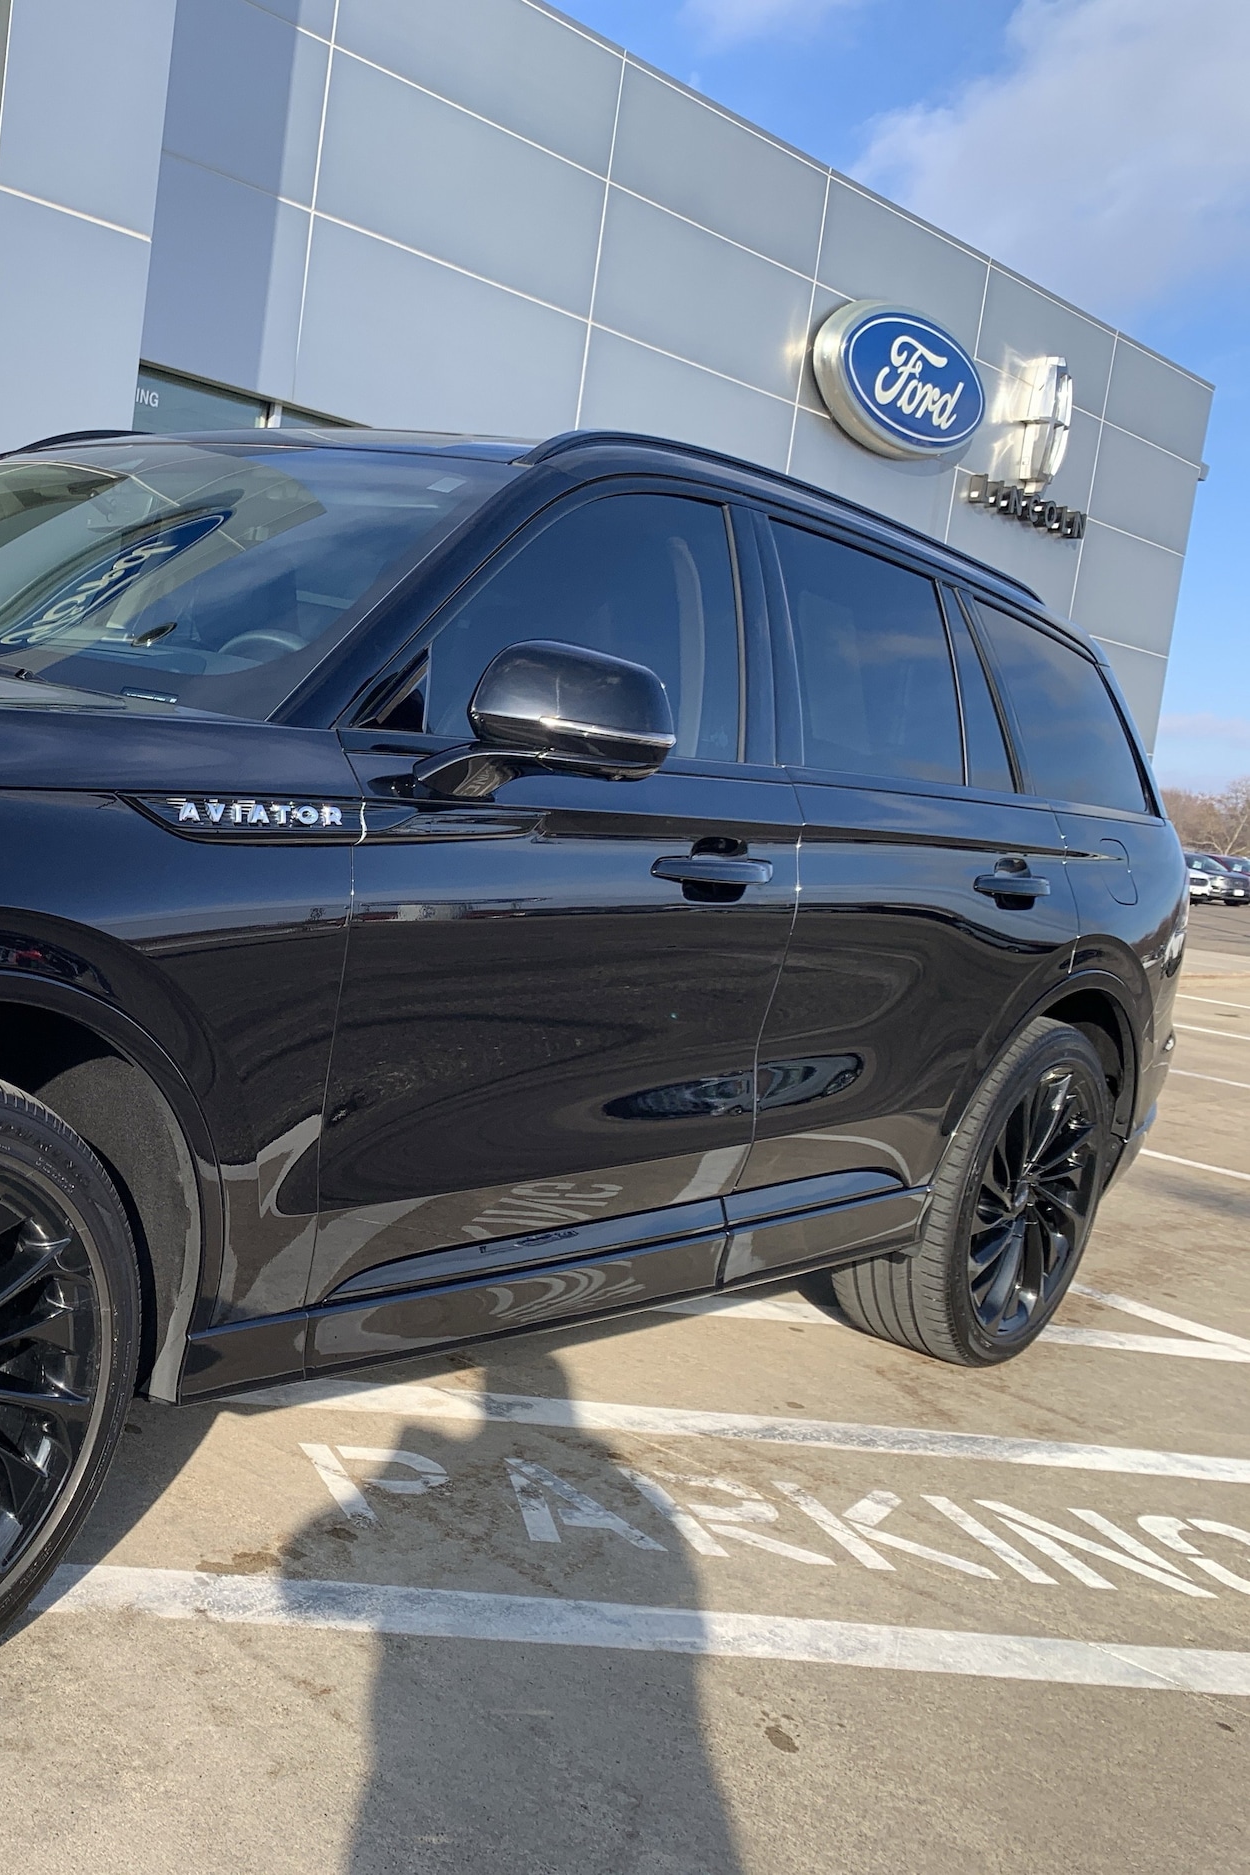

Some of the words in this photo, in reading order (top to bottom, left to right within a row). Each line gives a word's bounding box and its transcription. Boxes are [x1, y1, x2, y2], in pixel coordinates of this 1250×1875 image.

[874, 335, 964, 430] Ford
[968, 474, 1087, 538] LINCOLN
[178, 802, 343, 827] AVIATOR
